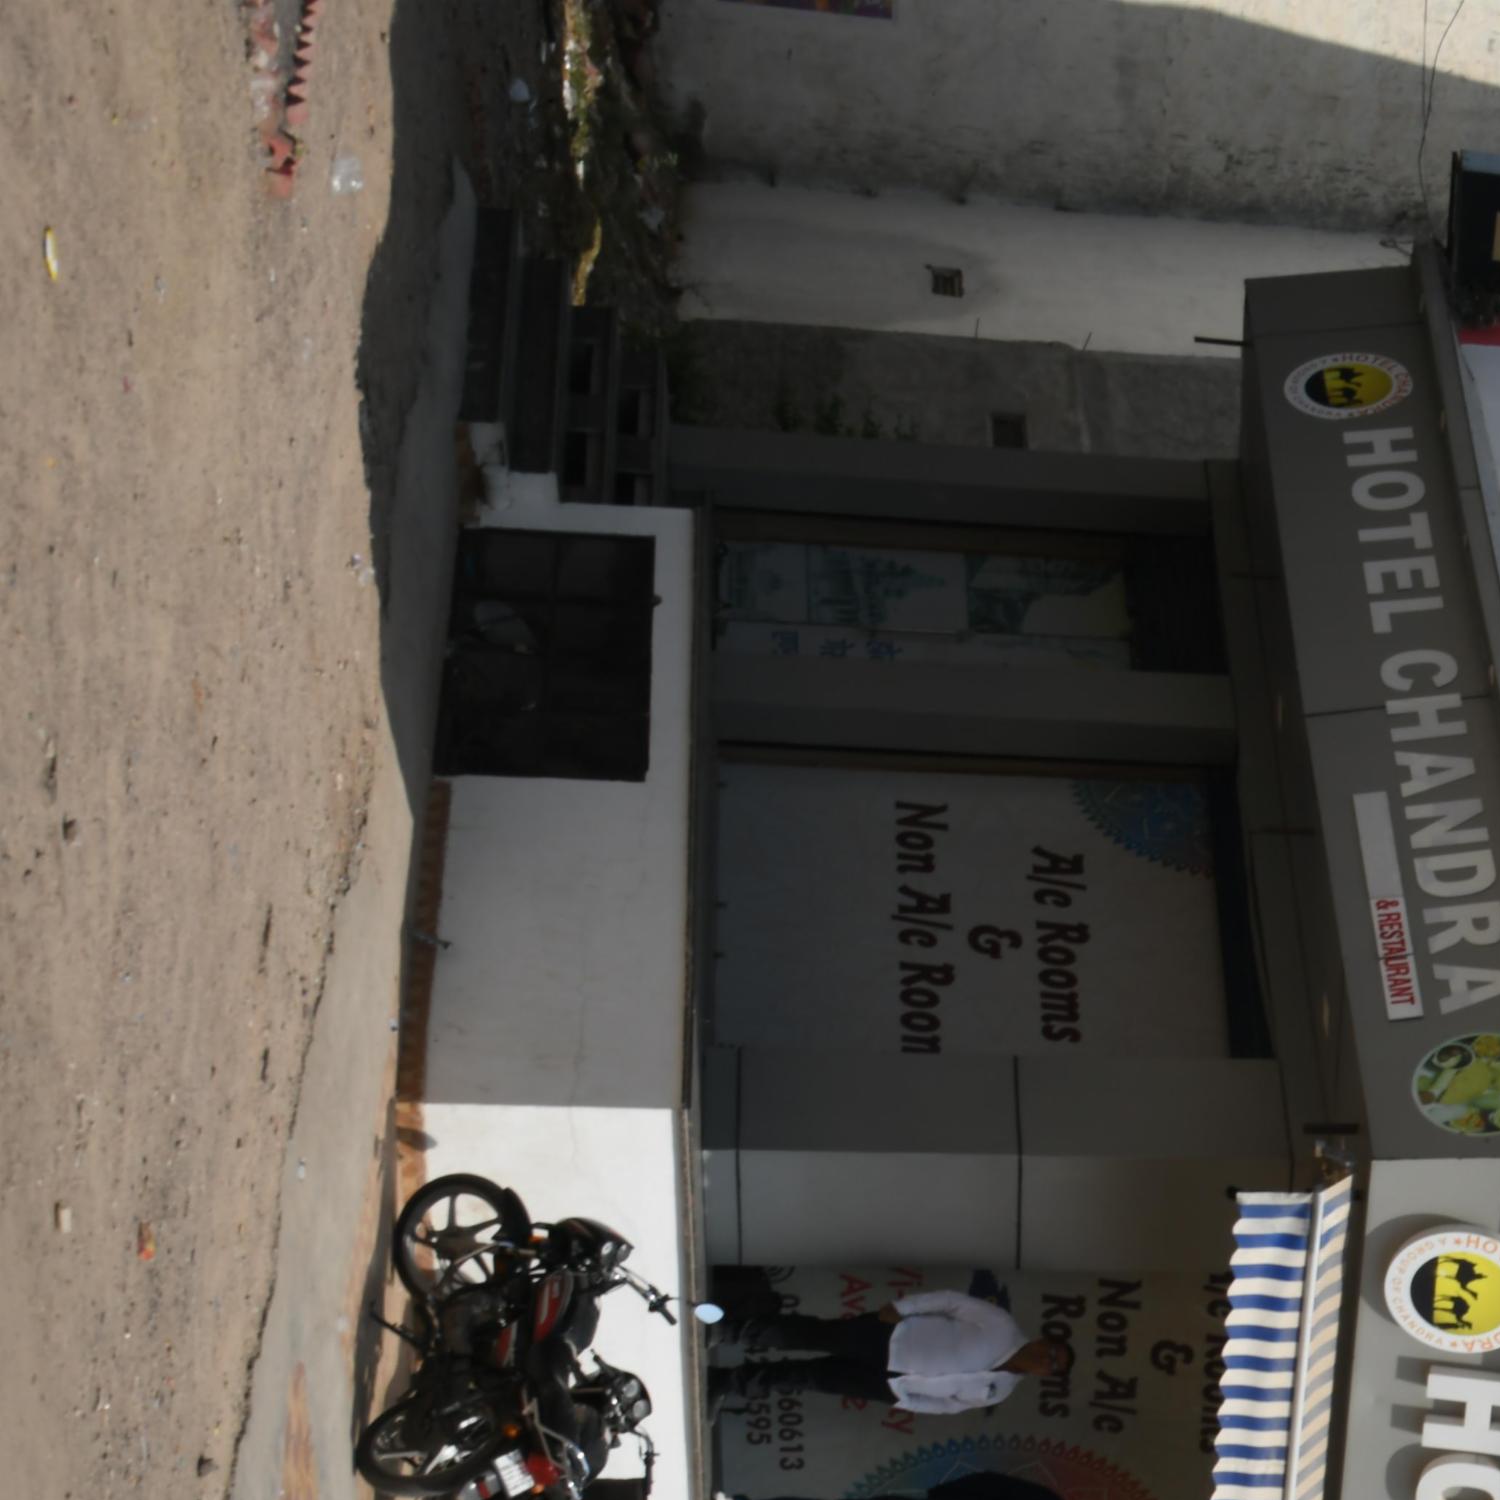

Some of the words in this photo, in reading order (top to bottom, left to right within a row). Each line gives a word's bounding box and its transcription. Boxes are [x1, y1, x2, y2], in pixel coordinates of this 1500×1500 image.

[1341, 426, 1444, 633] HOTEL
[895, 801, 950, 875] Non
[1026, 846, 1087, 909] A/c
[1376, 899, 1399, 910] &
[891, 885, 955, 949] A/c
[968, 924, 1023, 960] &
[1036, 920, 1091, 1043] Rooms
[1377, 912, 1415, 1005] RESTAURANT
[1095, 1278, 1142, 1358] Non
[1039, 1293, 1086, 1419] Roms
[1151, 1340, 1195, 1375] &
[1089, 1370, 1139, 1435] A/c
